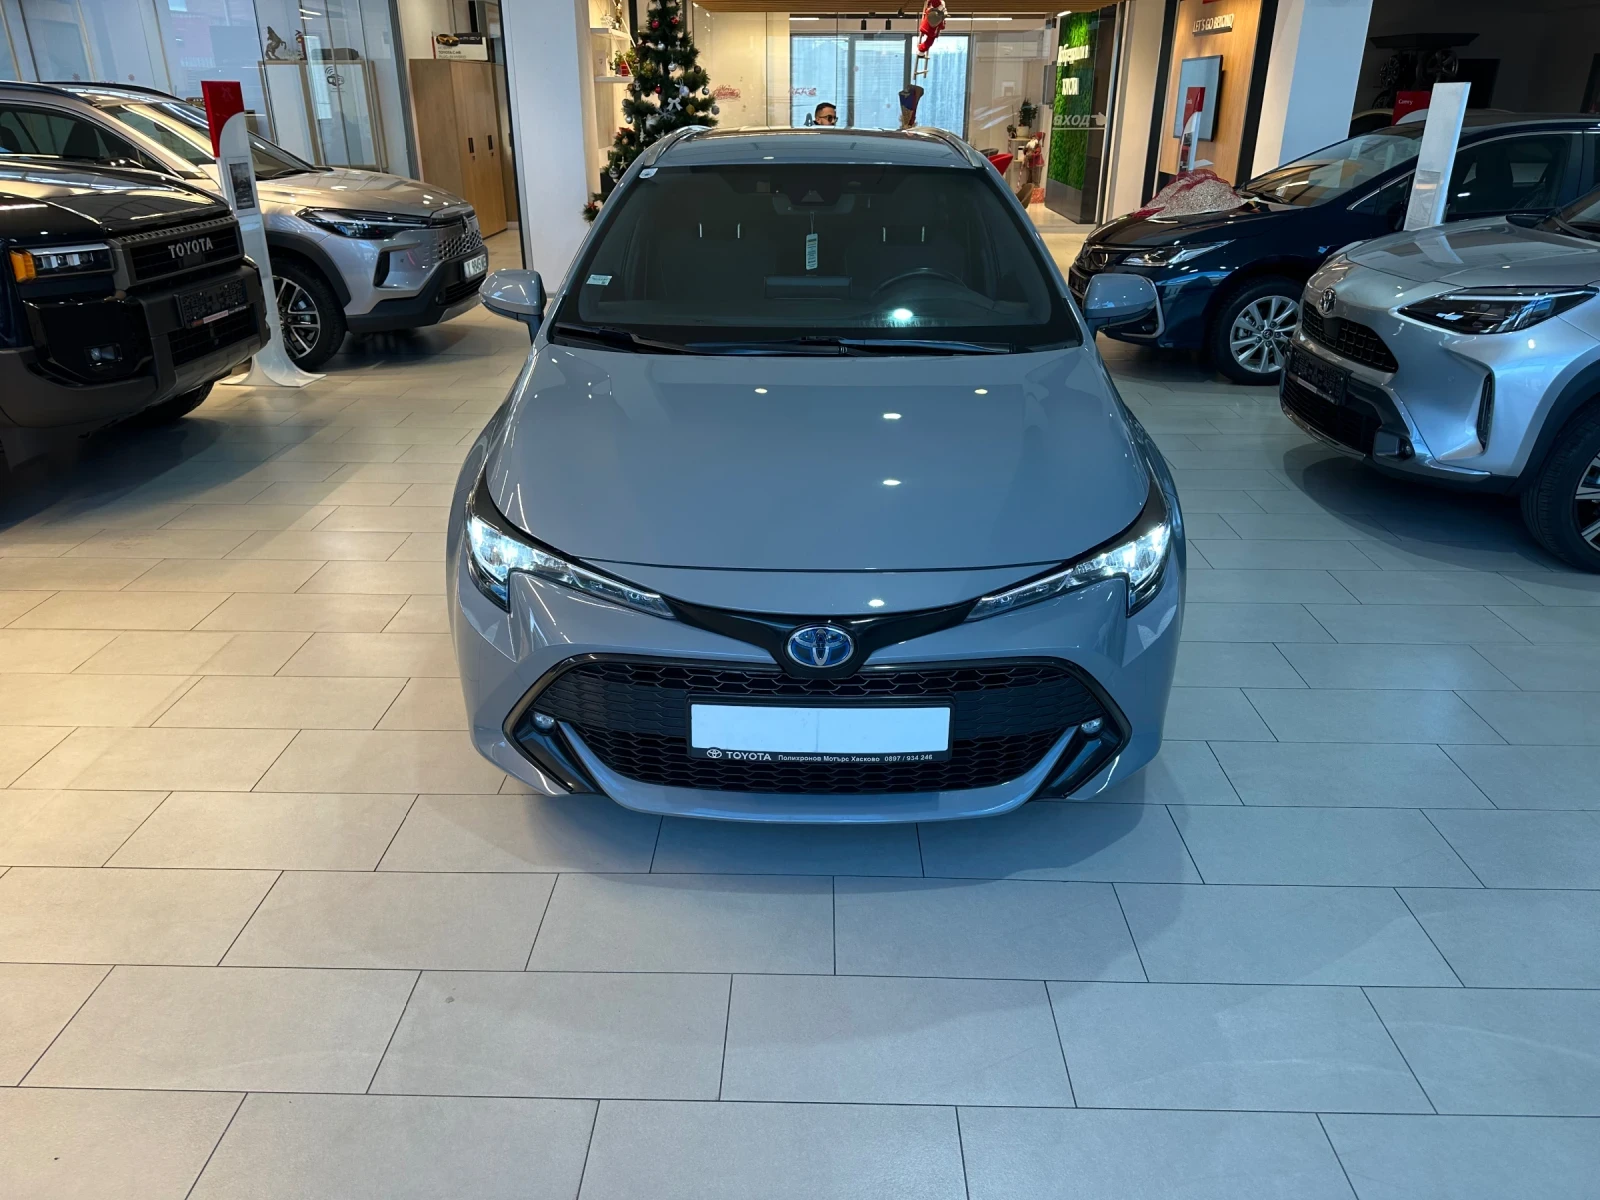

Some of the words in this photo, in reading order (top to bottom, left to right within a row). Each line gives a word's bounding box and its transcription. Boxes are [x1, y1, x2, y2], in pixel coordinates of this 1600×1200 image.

[1205, 18, 1213, 30] GO
[1398, 98, 1414, 106] Camry
[168, 237, 214, 259] TOYOTA
[726, 751, 772, 761] TOYOTA
[778, 754, 822, 762] Полихронов
